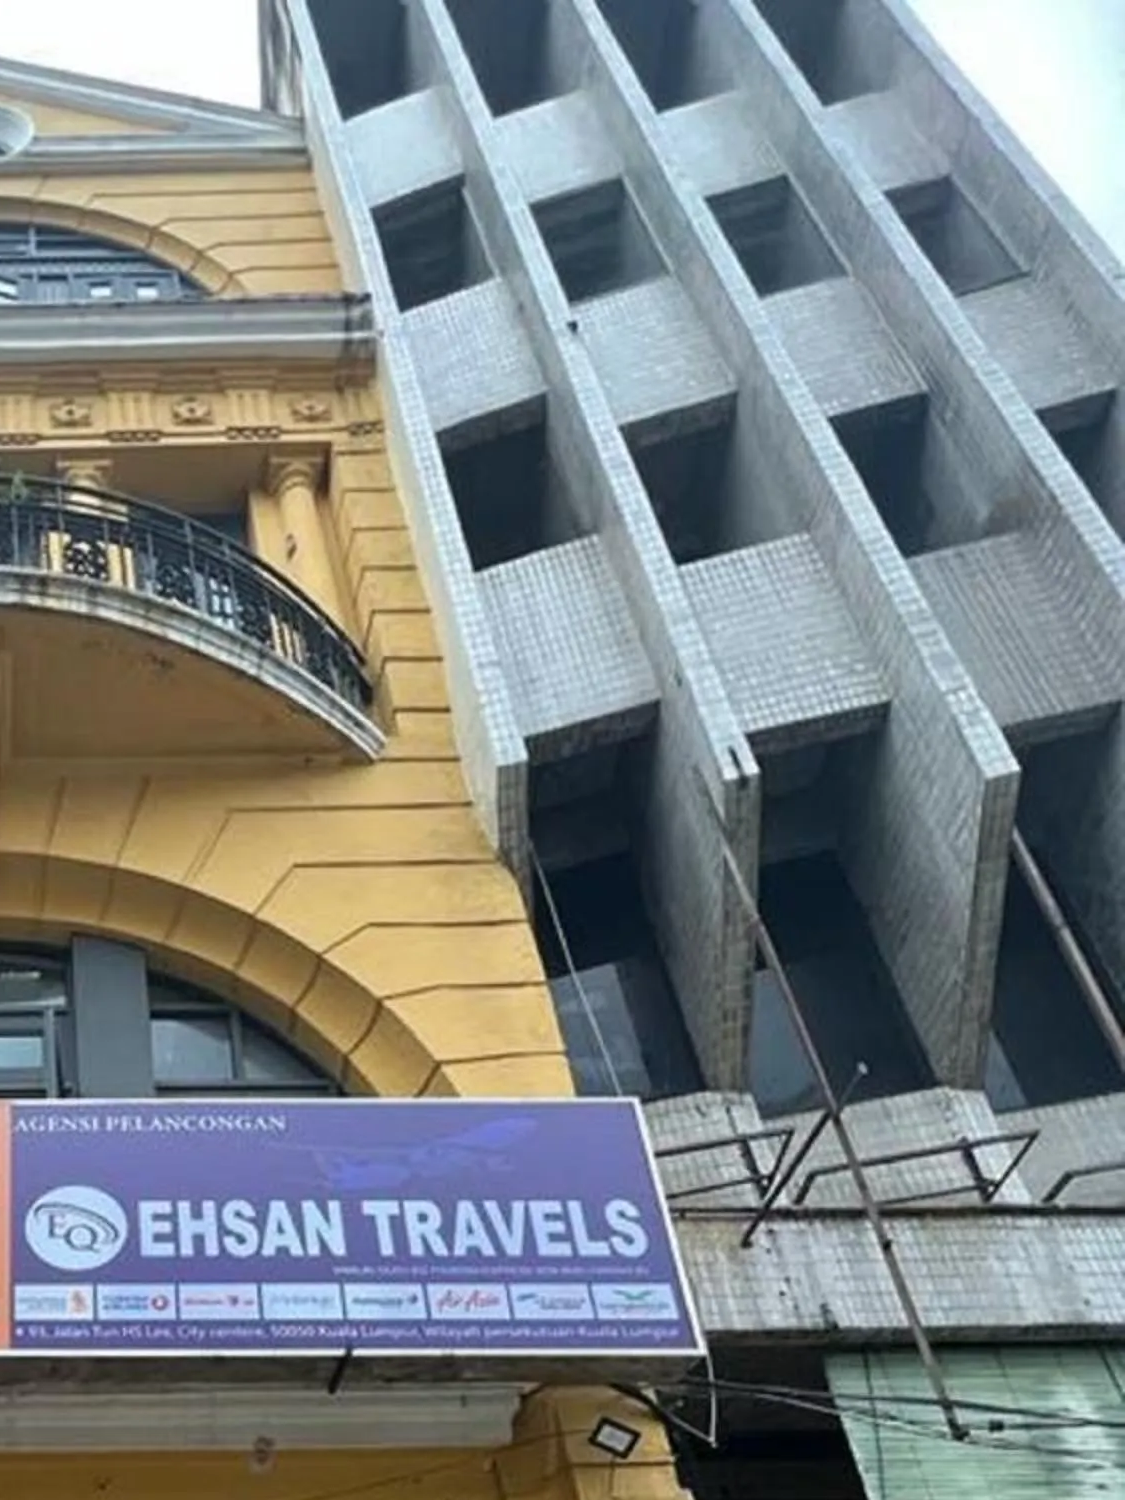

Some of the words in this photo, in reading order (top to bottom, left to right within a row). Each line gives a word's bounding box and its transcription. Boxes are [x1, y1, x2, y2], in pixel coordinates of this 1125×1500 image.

[15, 1115, 98, 1132] AGENSI
[106, 1114, 287, 1132] PELANCONGAN
[138, 1199, 348, 1258] EHSAN
[362, 1199, 650, 1258] TRAVELS
